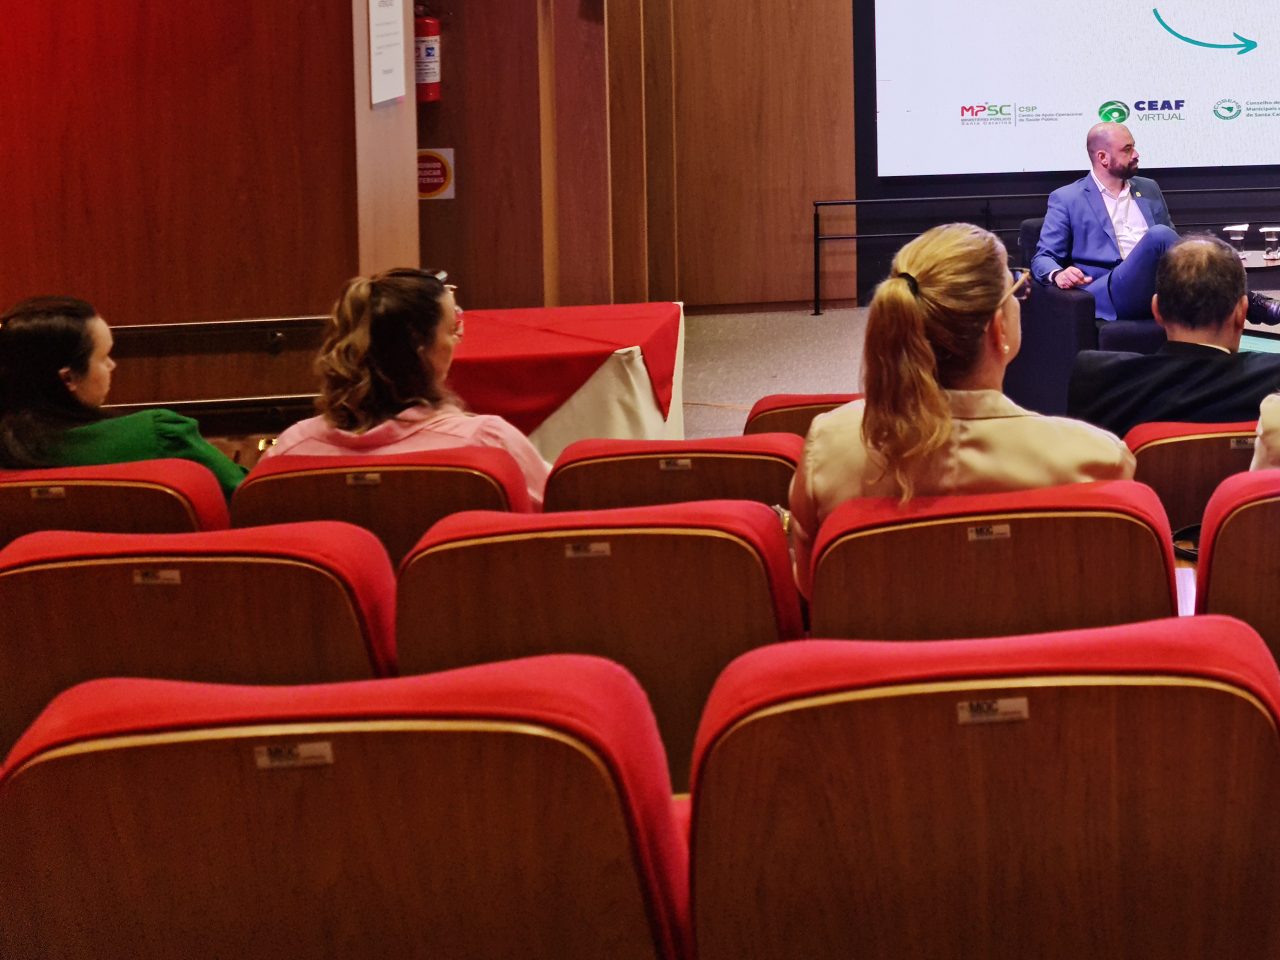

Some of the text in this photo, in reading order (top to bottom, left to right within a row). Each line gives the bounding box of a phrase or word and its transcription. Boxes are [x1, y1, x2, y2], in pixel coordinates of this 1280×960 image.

[960, 104, 1012, 117] MPSC
[1134, 100, 1185, 111] CEAF
[1137, 113, 1185, 121] VIRTUAL
